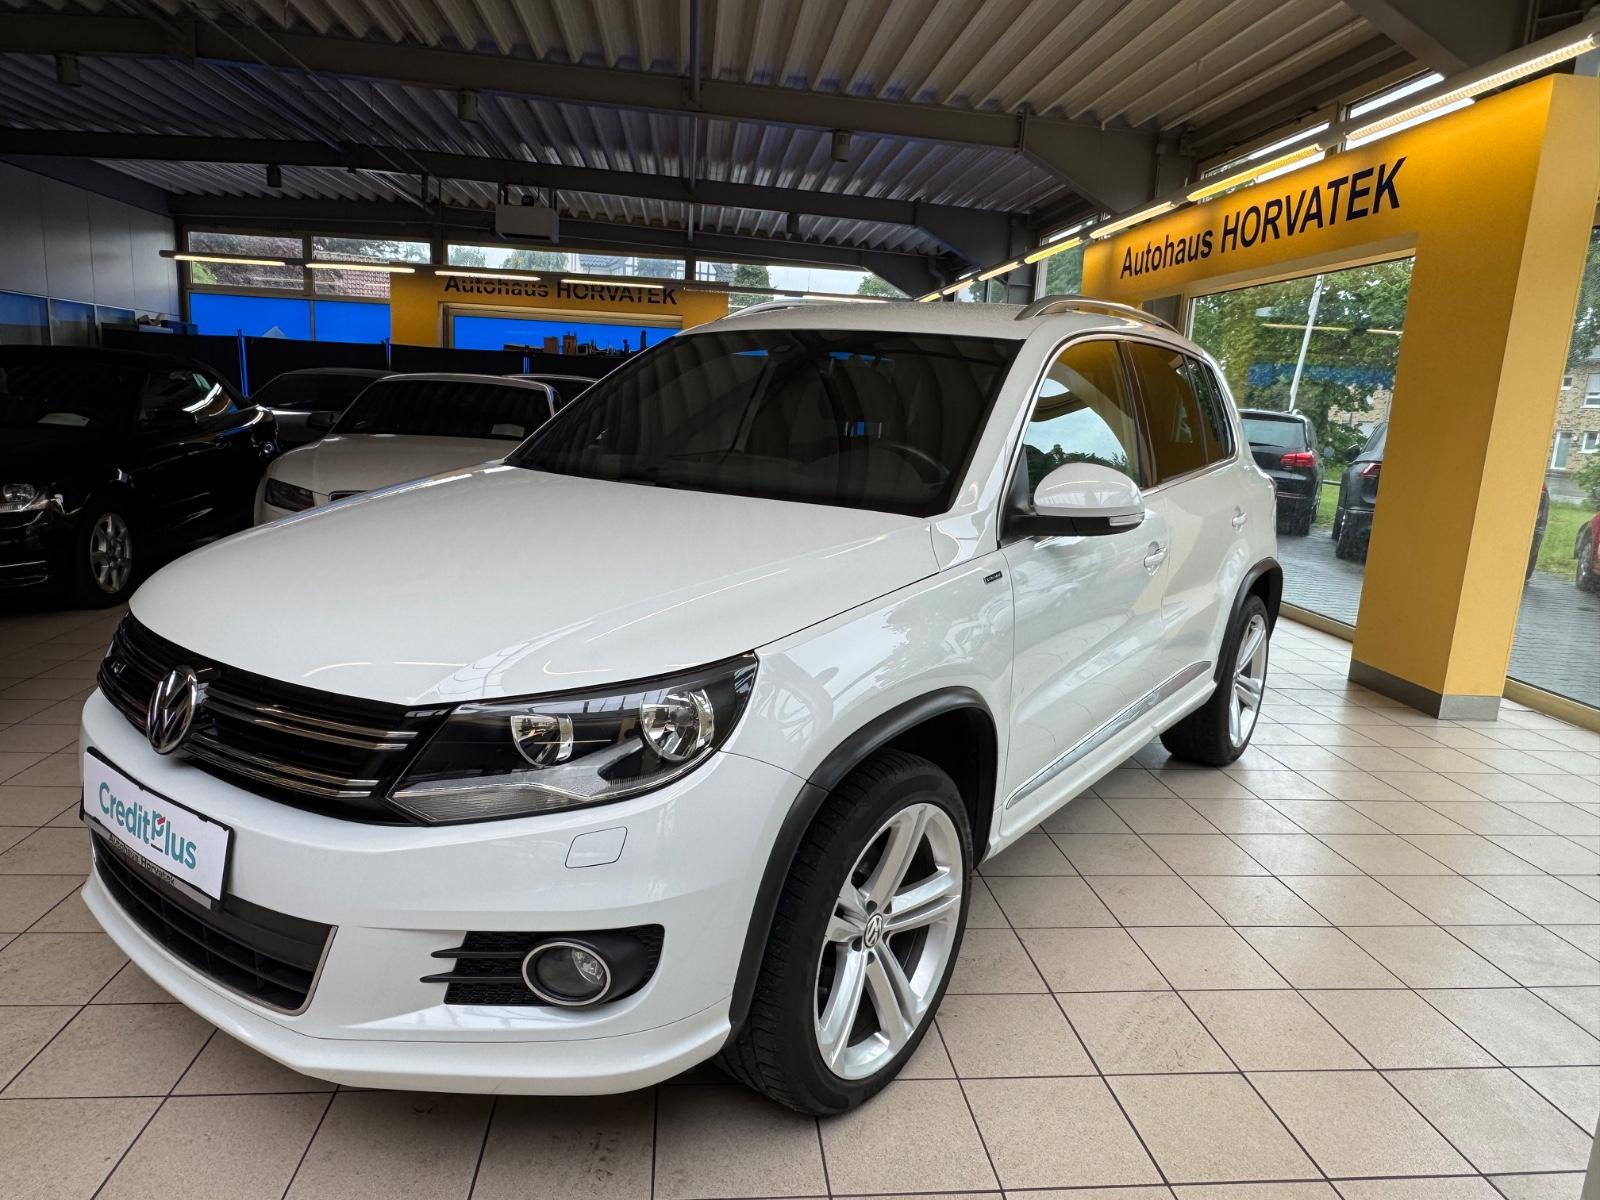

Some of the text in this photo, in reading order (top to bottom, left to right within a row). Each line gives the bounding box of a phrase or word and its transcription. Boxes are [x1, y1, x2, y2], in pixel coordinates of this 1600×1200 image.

[1120, 156, 1407, 279] Autohaus HORVATEK
[444, 276, 549, 298] Autohaus
[98, 781, 197, 870] CreditPlus
